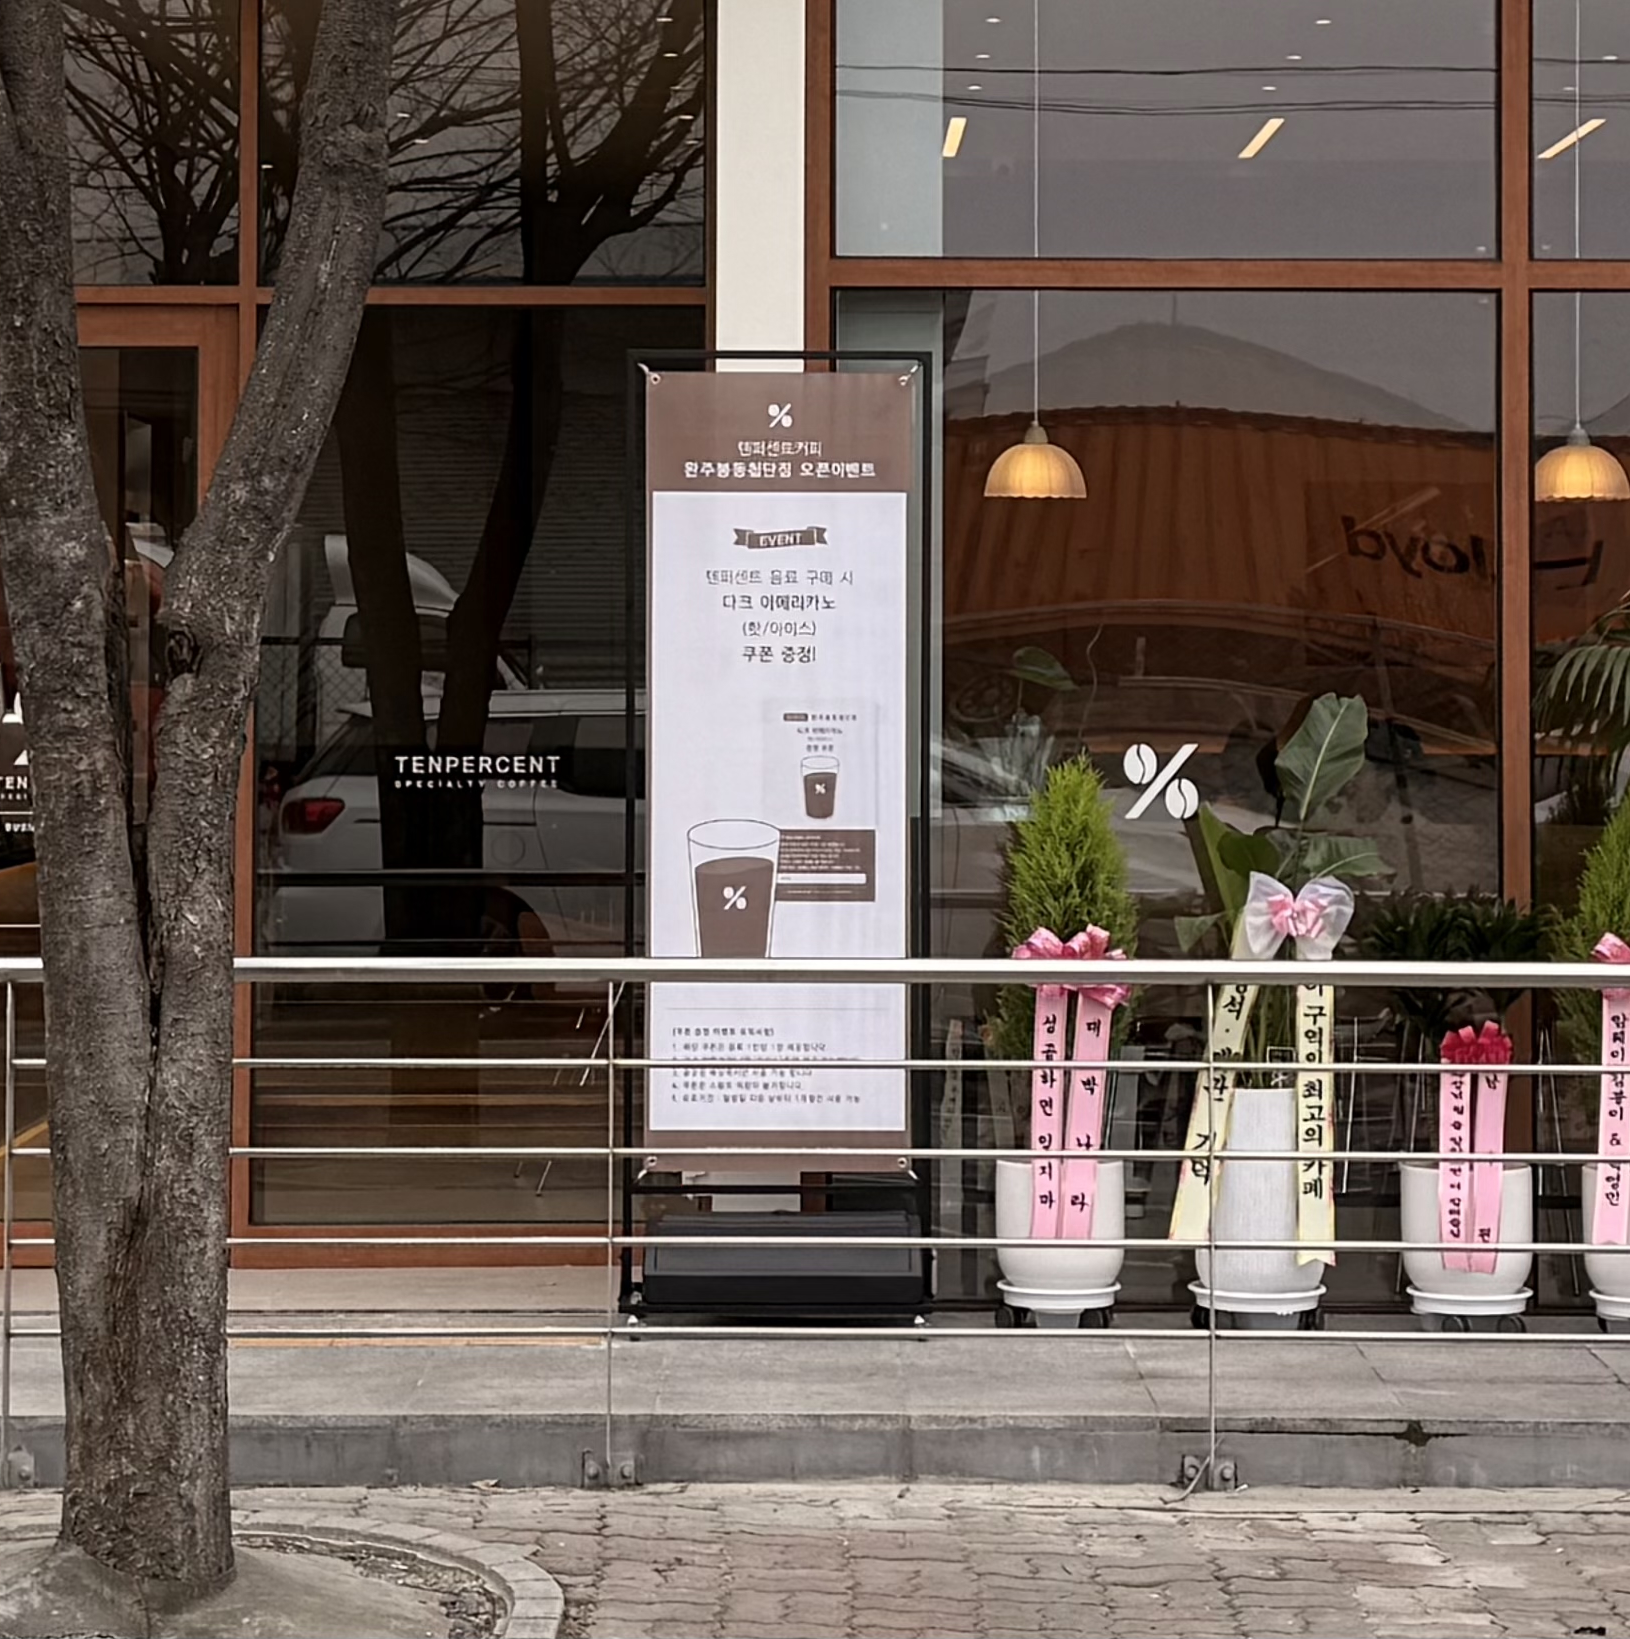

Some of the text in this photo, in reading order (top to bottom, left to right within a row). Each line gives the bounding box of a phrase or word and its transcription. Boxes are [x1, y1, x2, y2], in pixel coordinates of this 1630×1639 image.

[684, 462, 876, 478] 완주봉동첨단점 오픈이벤트
[759, 533, 803, 547] EVENT
[770, 569, 799, 586] 음료
[806, 569, 833, 586] 구매
[839, 570, 854, 585] 시
[722, 594, 837, 611] 다크 아메리카노
[742, 620, 817, 637] (핫/아이스)
[743, 645, 817, 664] 쿠폰 증정!
[394, 756, 561, 774] TENPERCENT
[394, 779, 558, 789] SPECIALTY COFFEE
